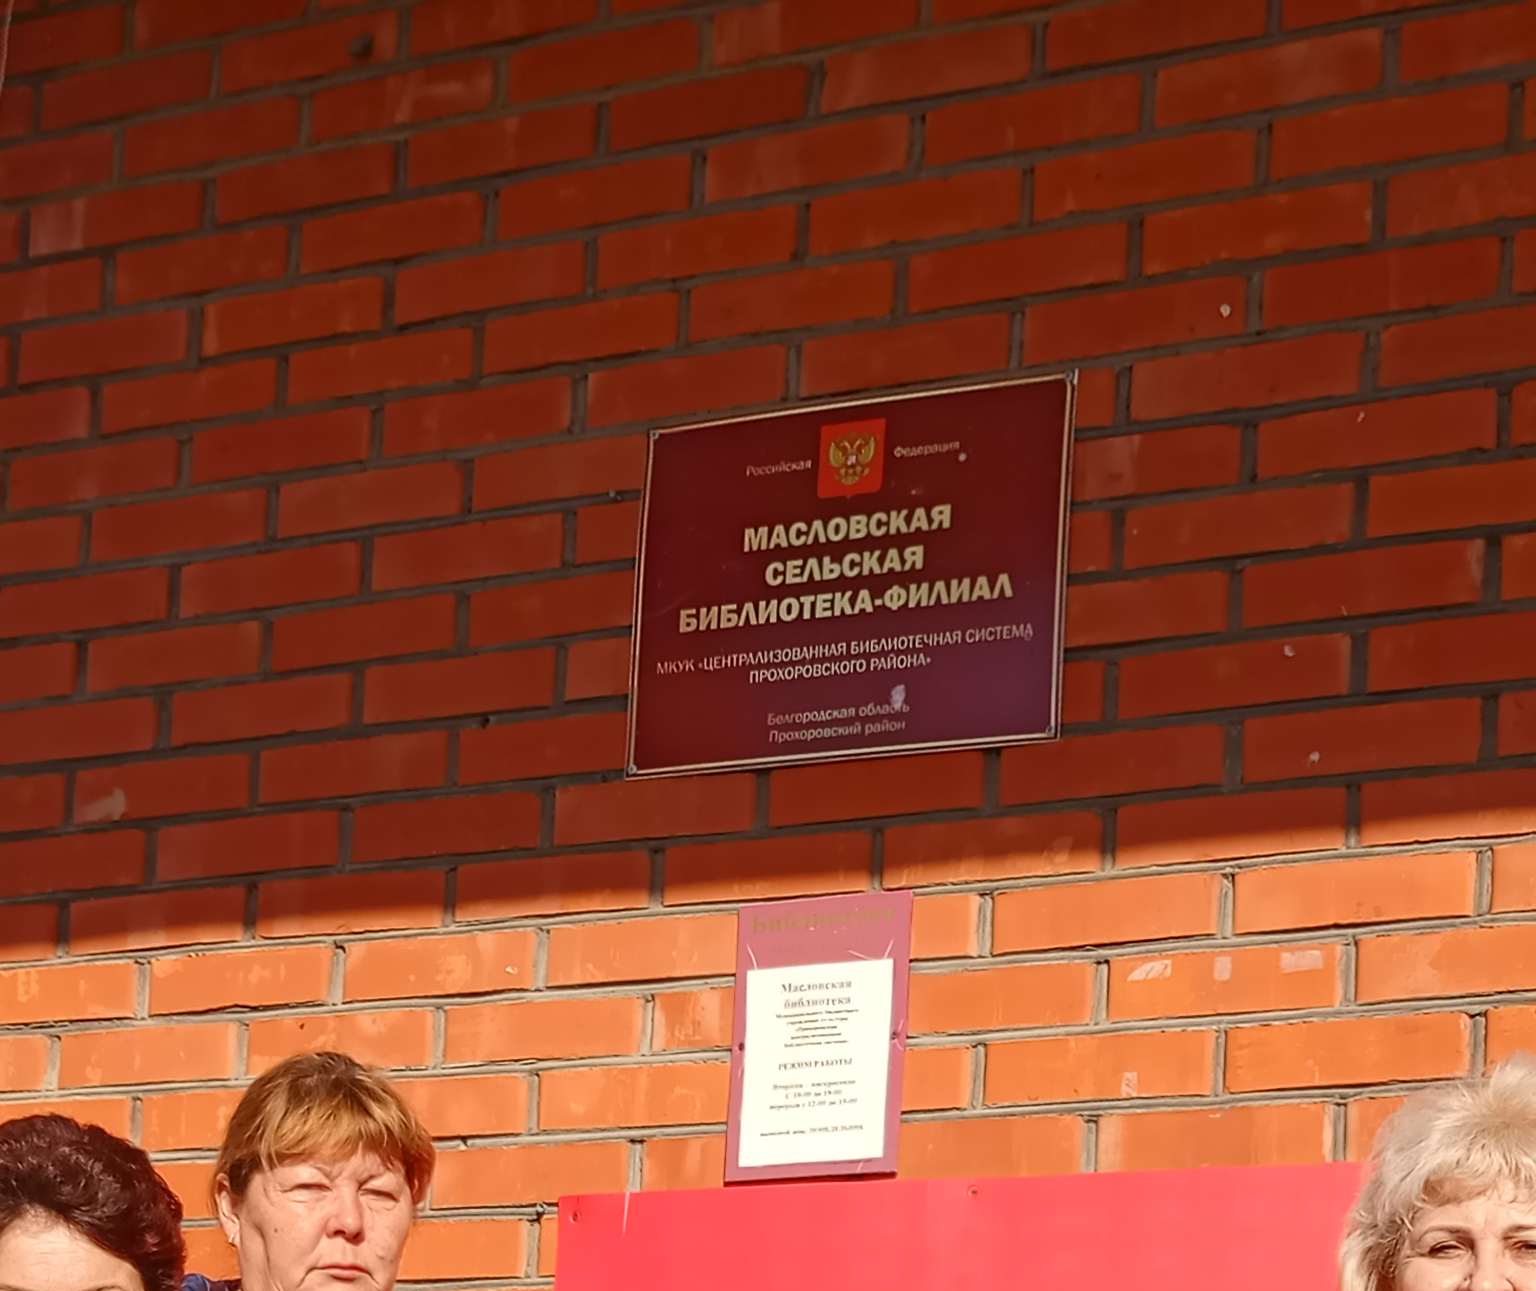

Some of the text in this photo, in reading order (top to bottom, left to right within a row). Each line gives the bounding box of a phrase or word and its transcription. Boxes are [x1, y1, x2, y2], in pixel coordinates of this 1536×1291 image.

[746, 441, 960, 477] Российская Федерация
[743, 503, 953, 553] МАСЛОВСКАЯ
[765, 545, 926, 587] СЕЛЬСКАЯ
[679, 573, 1013, 633] БИБЛИОТЕКА-ФИЛИАЛ
[657, 623, 1034, 675] МКУК «ЦЕНТРАЛИЗОВАННАЯ БИБЛИОТЕЧНАЯ СИСТЕМА
[749, 652, 931, 684] ПРОХОРОВСКОГО РАЙОНА»
[767, 703, 910, 725] Белгородская область
[769, 720, 906, 743] Прохоровский район
[781, 980, 852, 994] Масловская
[783, 996, 852, 1010] библиотека
[814, 1058, 853, 1068] РАБОТЫ
